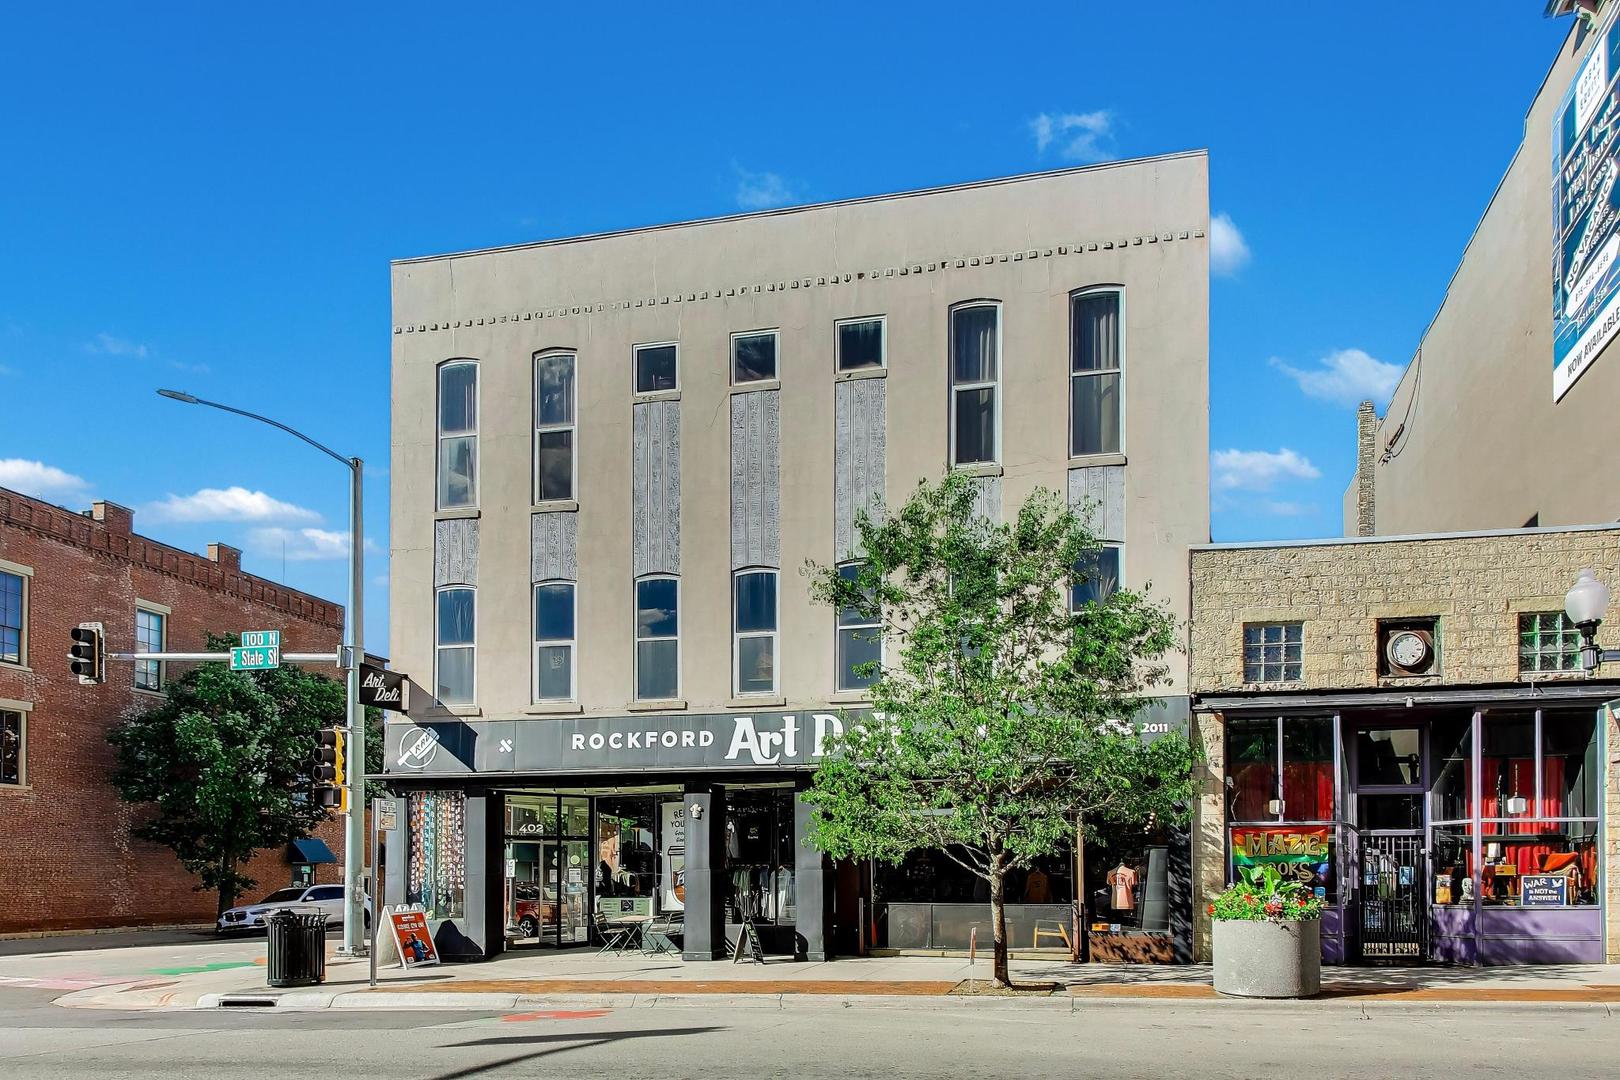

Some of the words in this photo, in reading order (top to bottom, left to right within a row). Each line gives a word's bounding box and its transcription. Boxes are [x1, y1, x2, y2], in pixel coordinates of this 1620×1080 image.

[1567, 261, 1578, 288] NO
[1579, 168, 1613, 254] VACANCY
[1567, 350, 1583, 378] NOW
[1583, 305, 1620, 360] AVAILABLE
[246, 633, 264, 646] 100
[269, 632, 276, 646] N
[232, 650, 238, 667] E
[241, 650, 264, 666] State
[268, 648, 277, 665] St
[362, 672, 387, 688] Art
[374, 687, 401, 702] Deli
[1141, 722, 1168, 733] 2011
[571, 730, 714, 750] ROCKFORD
[724, 715, 801, 765] Art
[519, 823, 544, 834] 402
[1245, 832, 1320, 857] MAZE
[1523, 877, 1548, 889] WAR
